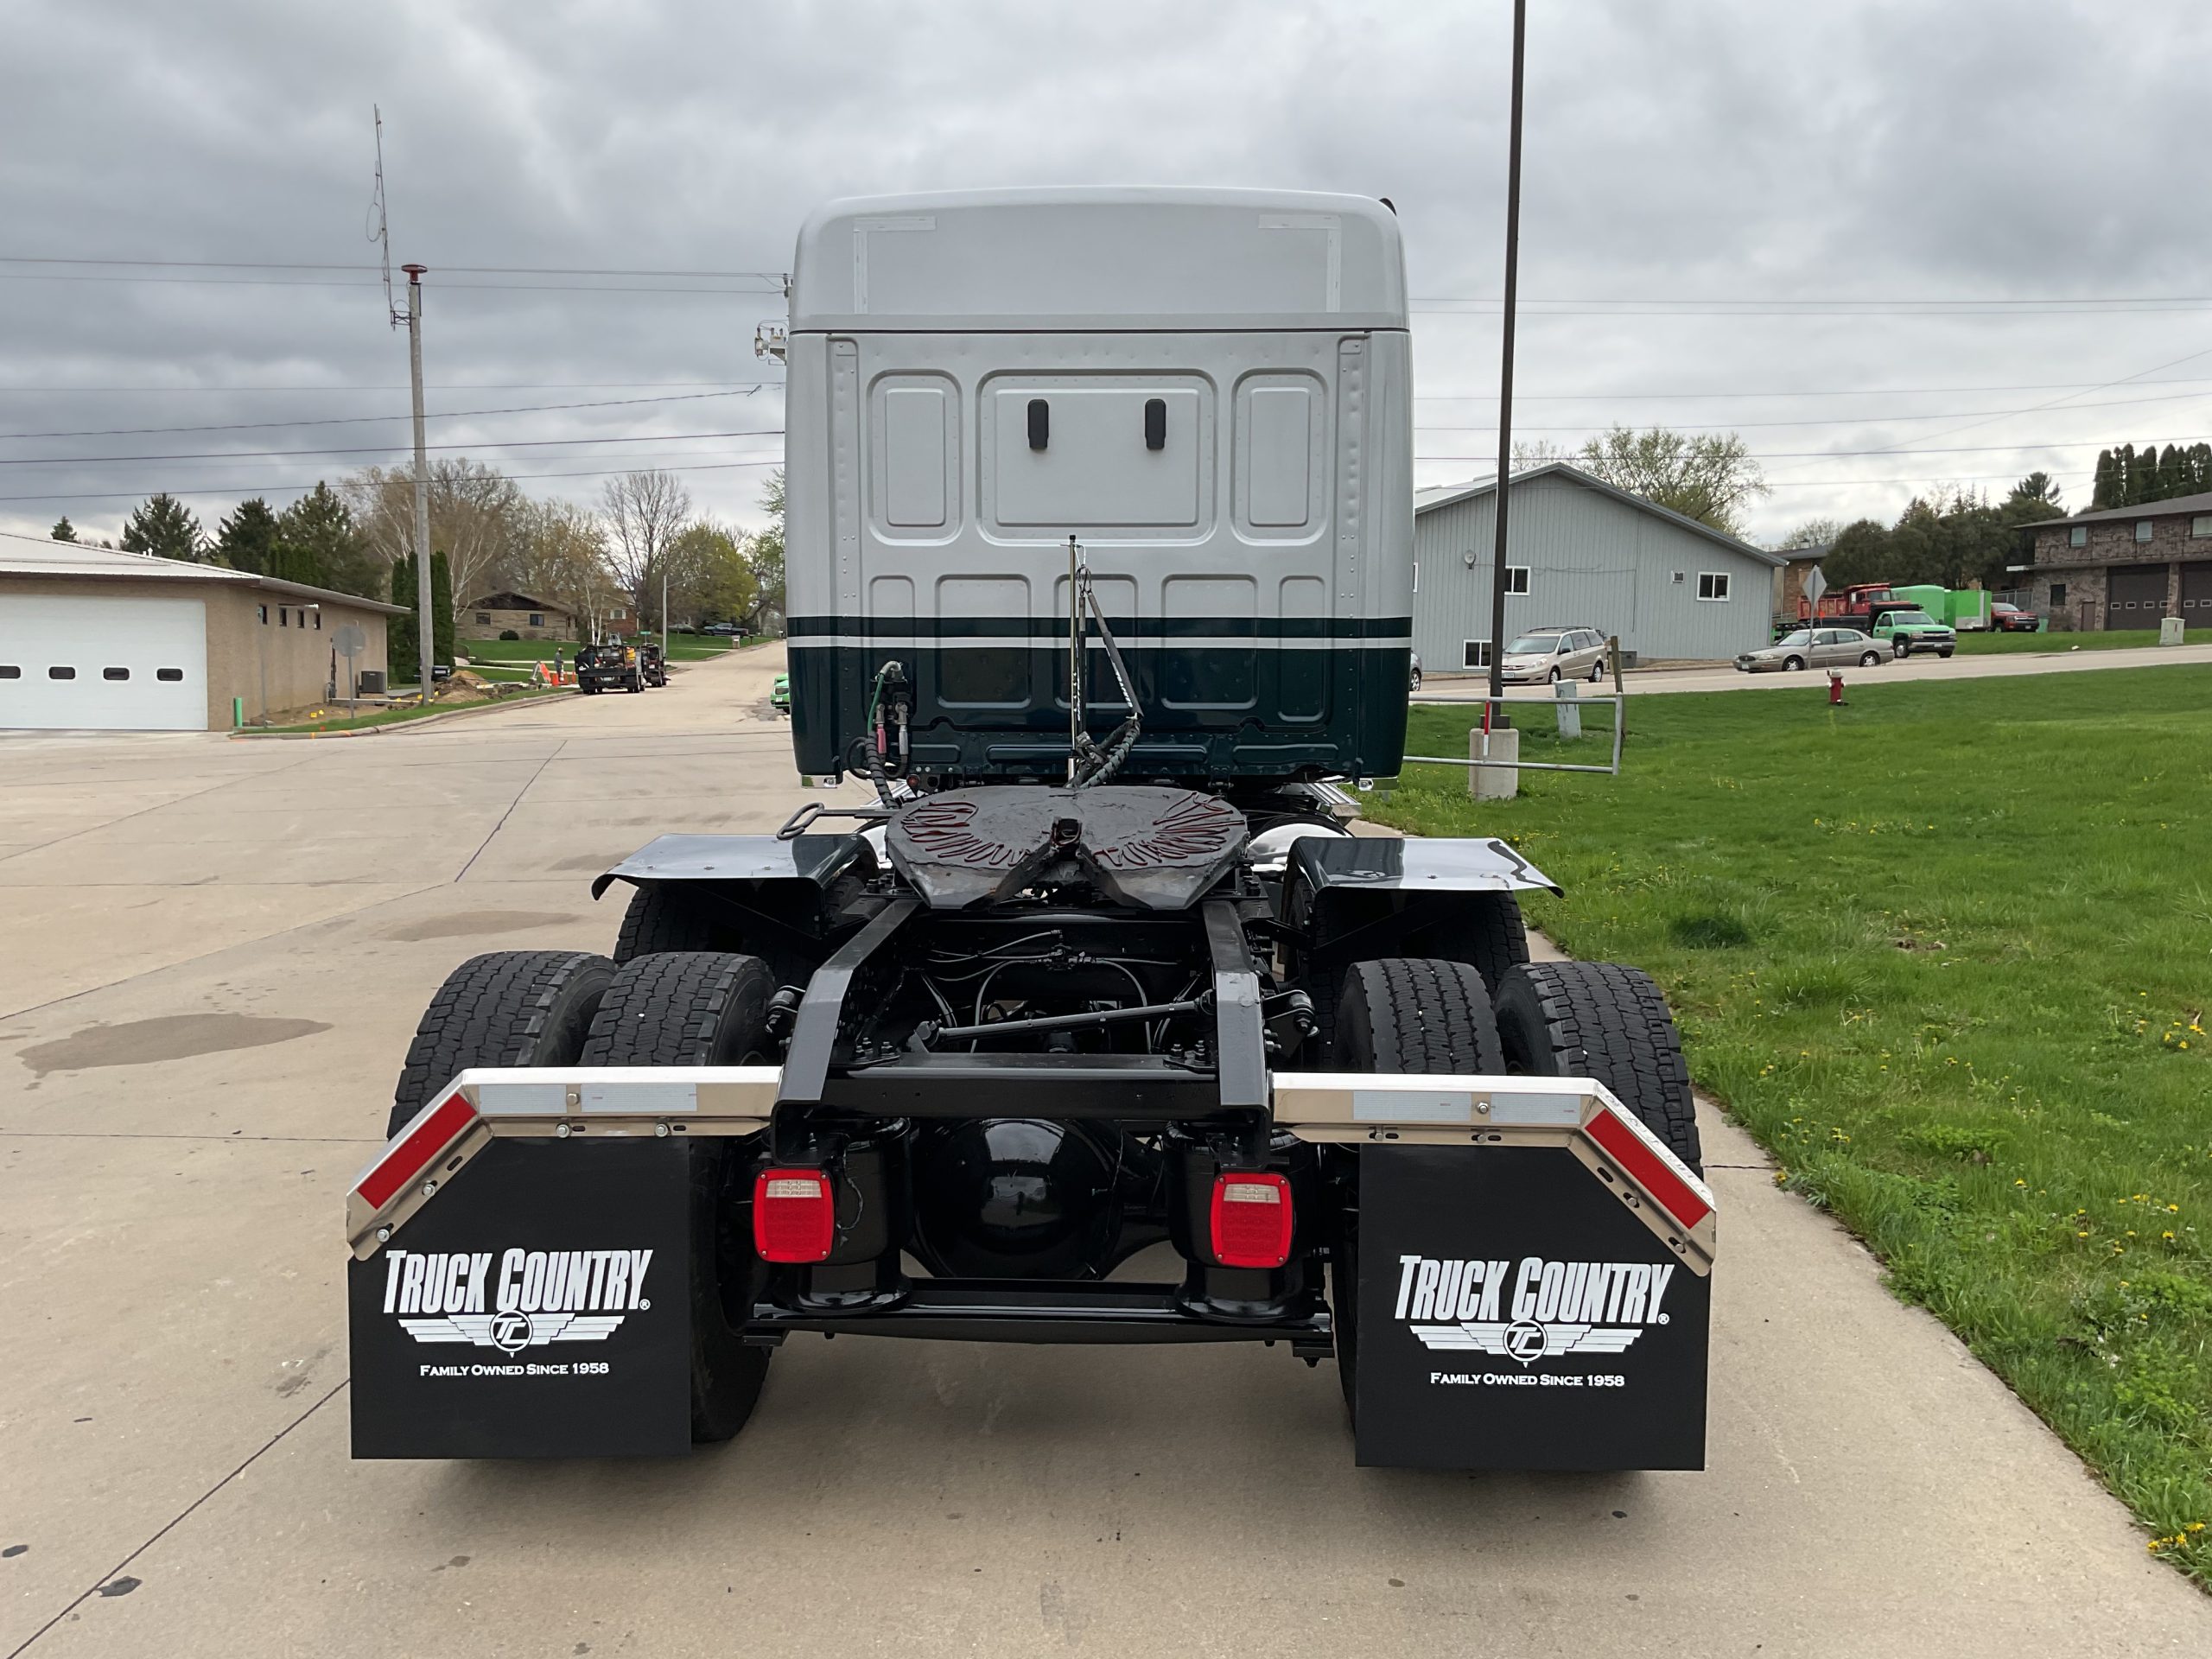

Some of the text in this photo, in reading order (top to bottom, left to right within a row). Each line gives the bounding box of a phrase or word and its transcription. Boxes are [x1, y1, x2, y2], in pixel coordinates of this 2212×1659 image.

[383, 1249, 493, 1314] TRUCK
[1394, 1255, 1510, 1321] TRUCK
[420, 1362, 610, 1376] FAMILY OWNED SINCE 1958
[1430, 1371, 1625, 1387] FAMILY OWNED SINCE 1958
